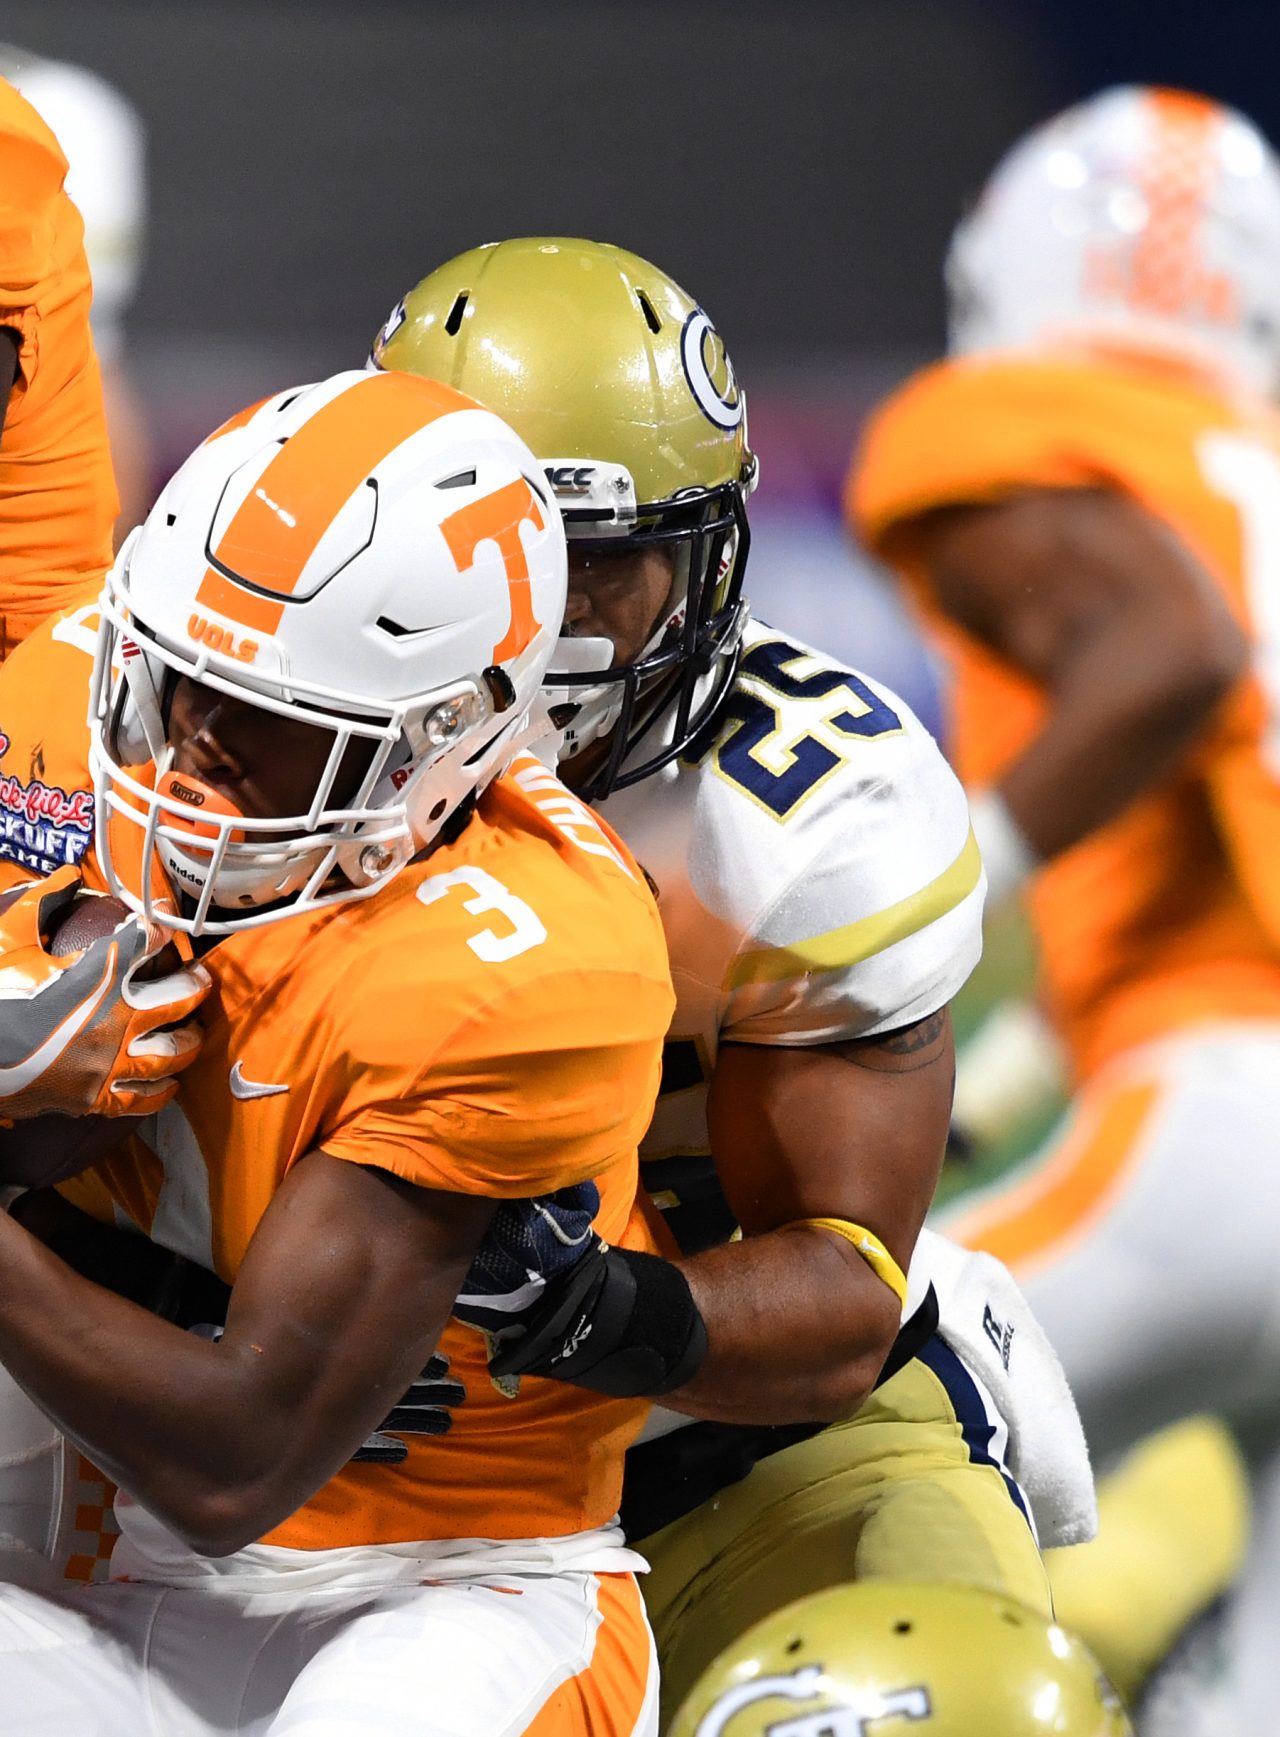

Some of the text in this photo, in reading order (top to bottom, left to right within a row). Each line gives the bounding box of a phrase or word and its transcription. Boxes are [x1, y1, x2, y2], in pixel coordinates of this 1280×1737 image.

[187, 612, 259, 664] VOLS
[439, 478, 546, 663] T
[677, 639, 908, 826] 25
[415, 864, 549, 963] 3
